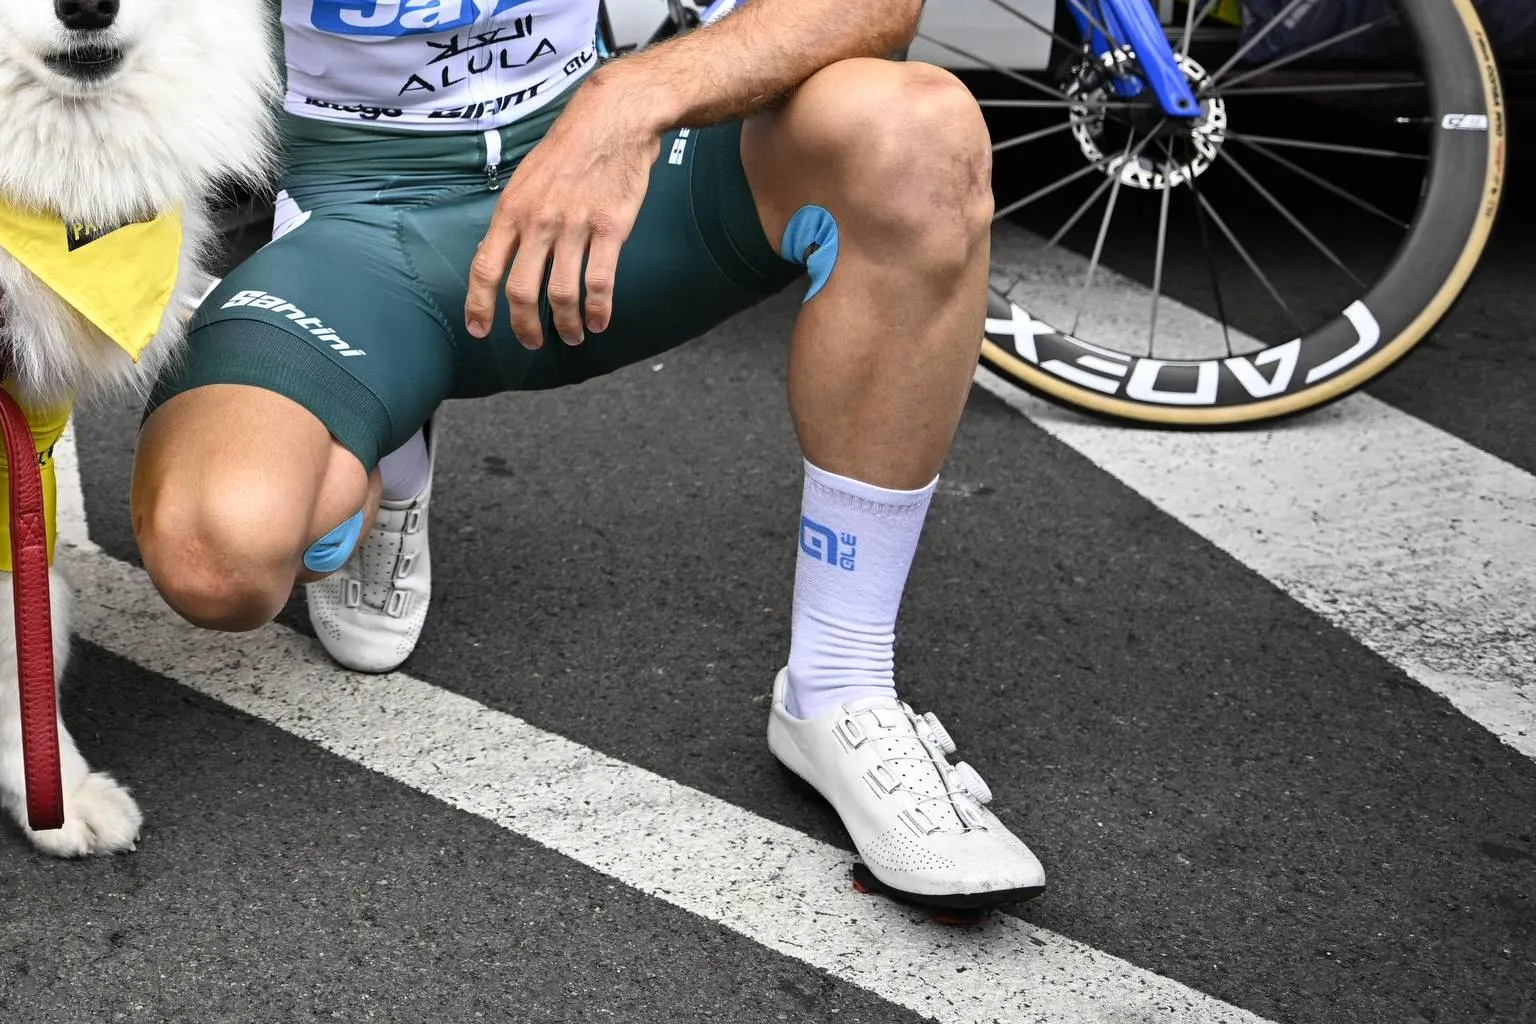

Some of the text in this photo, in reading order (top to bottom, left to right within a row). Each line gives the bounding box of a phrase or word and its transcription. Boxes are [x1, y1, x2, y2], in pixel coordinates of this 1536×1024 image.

[397, 37, 558, 97] ALULA
[427, 78, 552, 120] GIANT
[220, 289, 366, 360] Santini
[984, 299, 1380, 405] CADEX
